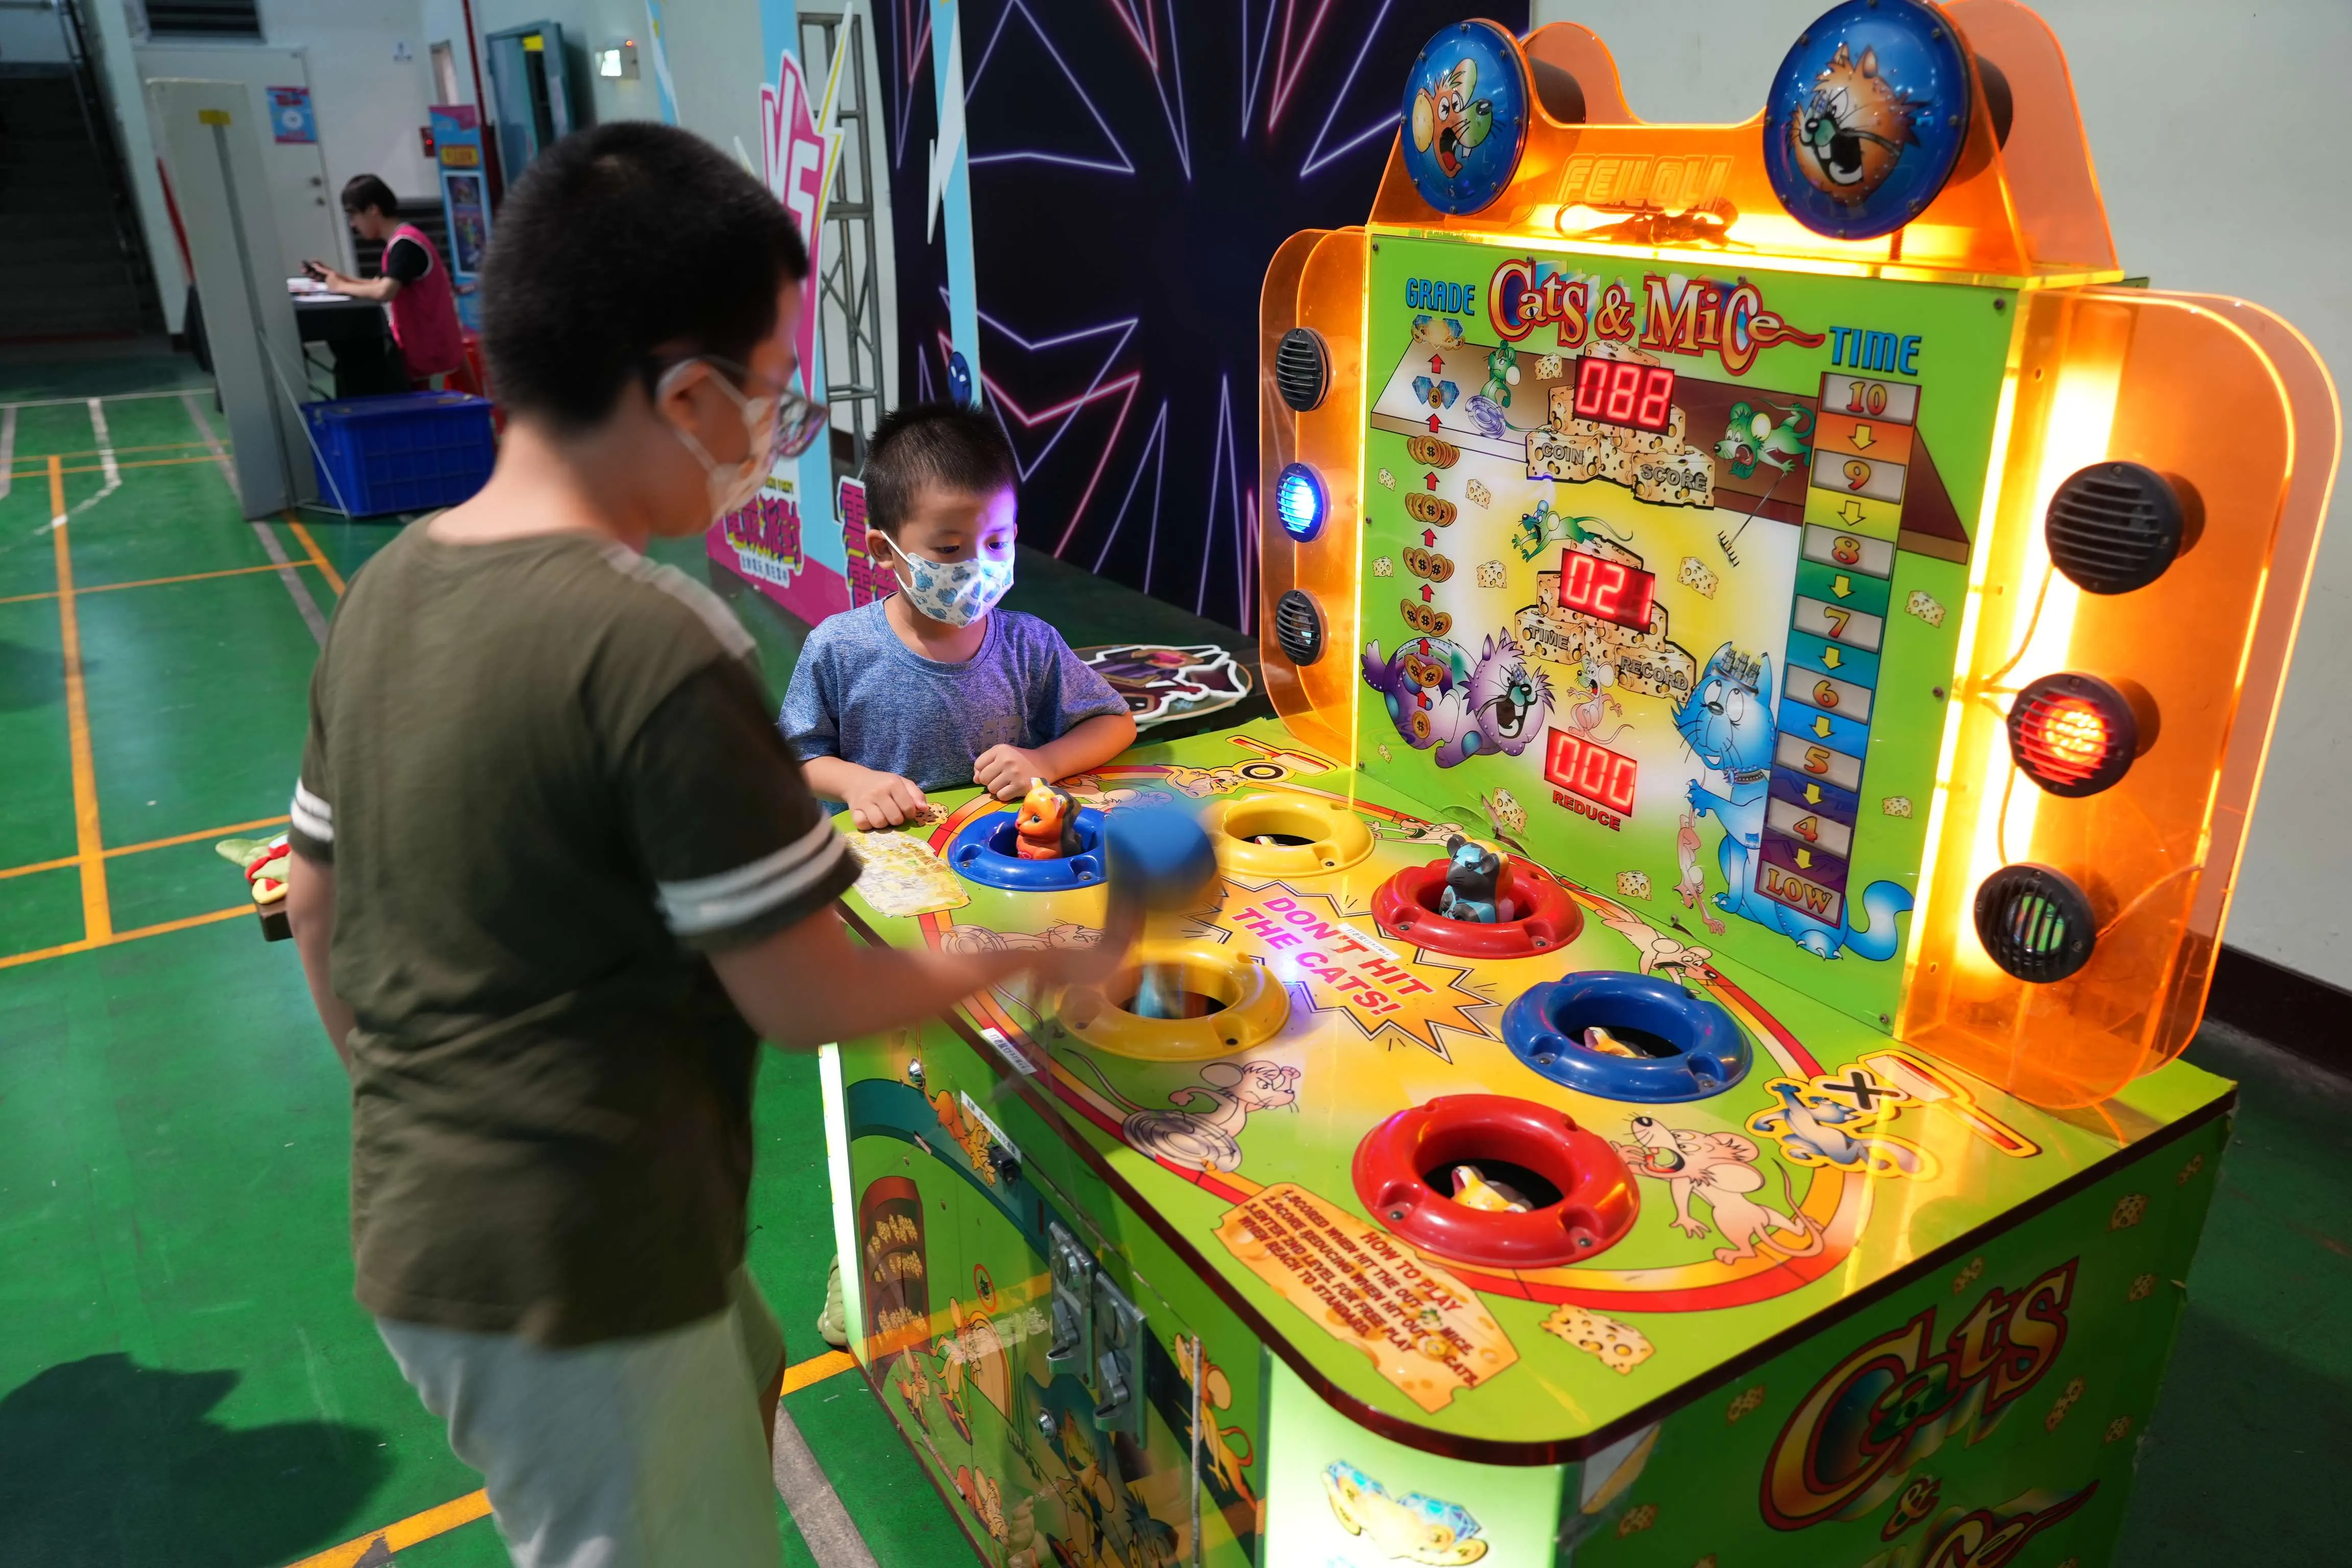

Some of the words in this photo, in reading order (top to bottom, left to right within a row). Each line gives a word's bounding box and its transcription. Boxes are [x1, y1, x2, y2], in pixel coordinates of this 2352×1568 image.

[1405, 278, 1475, 315] GRADE
[1595, 284, 1635, 343] &
[1829, 326, 1922, 376] TIME
[1575, 360, 1674, 426] 088
[1846, 381, 1887, 415] 10
[1542, 442, 1583, 465] COIN
[1843, 460, 1871, 491] 9
[1641, 464, 1707, 492] SCORE
[1831, 536, 1860, 565] 8
[1566, 554, 1654, 624] 021
[1529, 624, 1570, 650] TIME
[1824, 606, 1850, 638] 7
[1620, 656, 1688, 691] RECORD
[1812, 680, 1839, 708] 6
[1553, 735, 1636, 806] 000
[1804, 746, 1830, 774] 5
[1552, 790, 1621, 832] REDUCE
[1793, 816, 1818, 843] 4
[1766, 868, 1832, 914] LOW
[1232, 908, 1303, 949] THE
[1295, 951, 1402, 1015] CATS!
[1262, 897, 1369, 954] DON'T
[1358, 958, 1434, 995] HIT
[1238, 1215, 1271, 1241] WHEN
[1265, 1241, 1304, 1271] REACH
[1297, 1270, 1317, 1285] TO
[1326, 1227, 1359, 1253] WHEN
[1353, 1253, 1378, 1269] HIT
[1373, 1268, 1400, 1289] THE
[1395, 1288, 1424, 1308] OUT
[1360, 1231, 1402, 1261] HOW
[1396, 1260, 1421, 1279] TO
[1416, 1278, 1463, 1311] PLAY
[1281, 1236, 1307, 1255] 2ND
[1303, 1254, 1336, 1283] LEVEL
[1332, 1282, 1360, 1303] FOR
[1354, 1301, 1388, 1328] FREE
[1381, 1327, 1416, 1352] PLAY
[1300, 1230, 1355, 1273] REDUCING
[1350, 1272, 1386, 1302] WHEN
[1381, 1301, 1407, 1318] HIT
[1402, 1318, 1431, 1339] OUT
